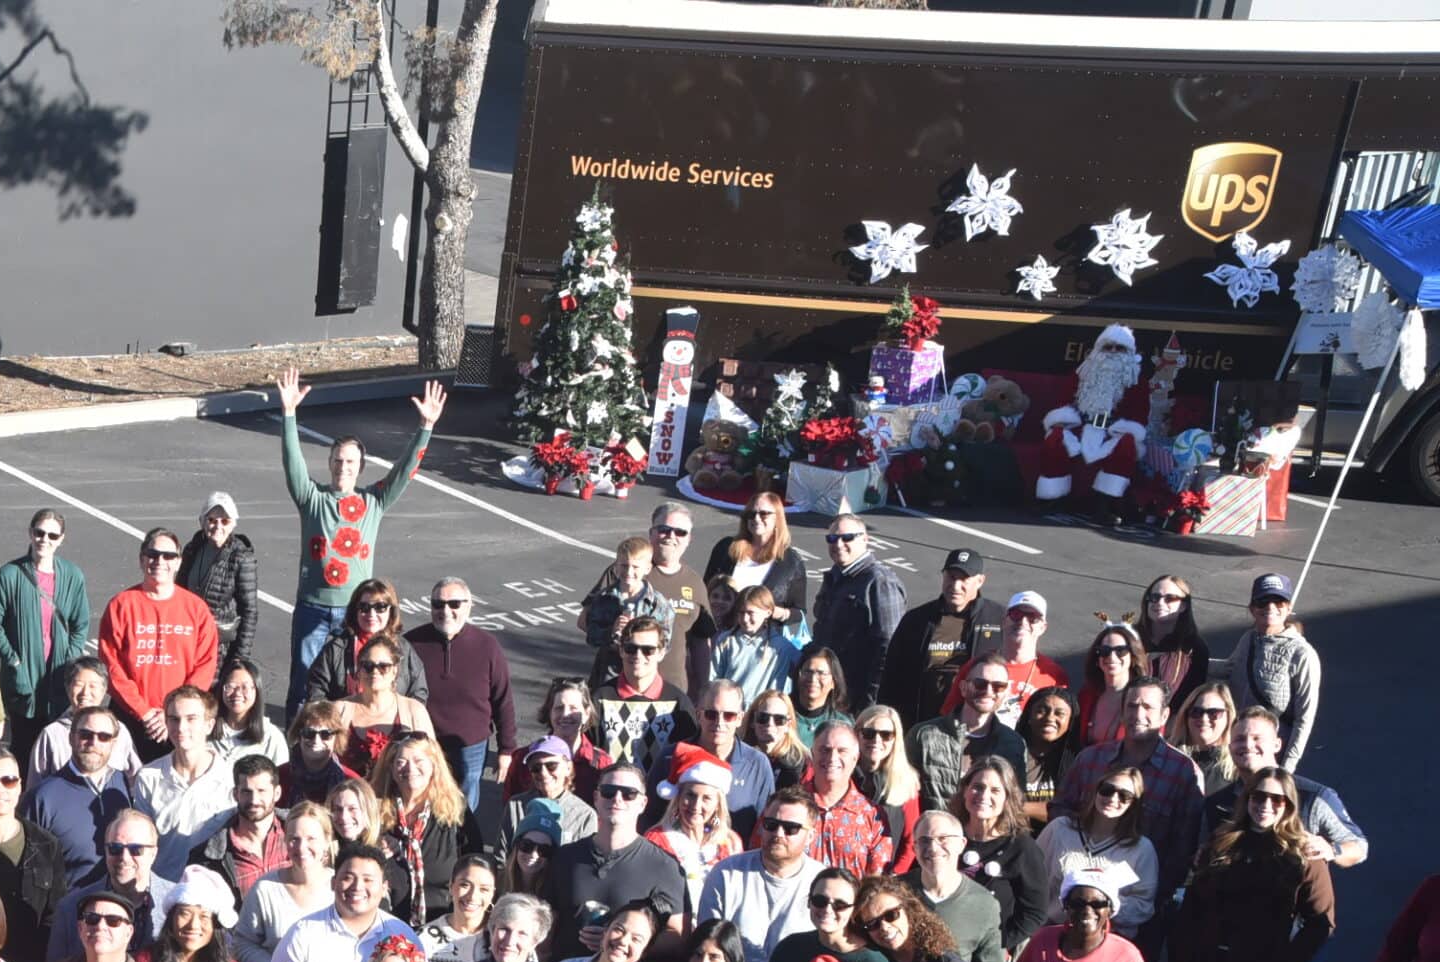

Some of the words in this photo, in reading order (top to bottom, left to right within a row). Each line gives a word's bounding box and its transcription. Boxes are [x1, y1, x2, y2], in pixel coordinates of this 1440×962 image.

[571, 155, 681, 183] Worldwide
[687, 162, 774, 189] Services
[1189, 173, 1269, 226] ups
[656, 410, 675, 465] SNOW
[136, 621, 194, 636] better
[136, 639, 165, 650] not
[136, 653, 178, 668] pout.
